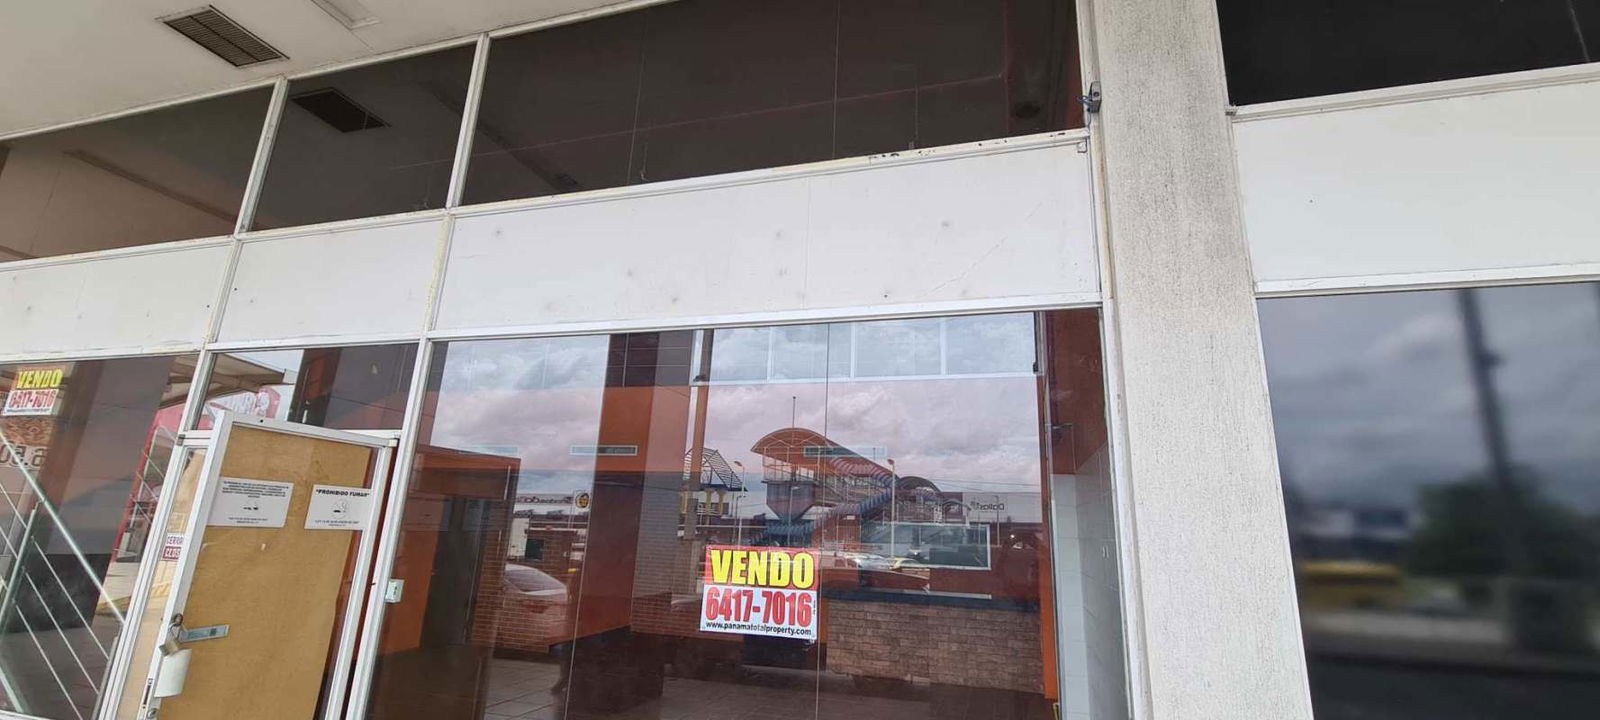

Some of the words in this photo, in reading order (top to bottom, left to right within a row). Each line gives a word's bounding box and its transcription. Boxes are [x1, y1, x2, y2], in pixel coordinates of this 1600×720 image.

[16, 369, 63, 389] VENDO
[710, 550, 815, 589] VENDO
[705, 586, 812, 628] 6417-7016
[706, 621, 812, 636] www.panamatotalproperty.com
